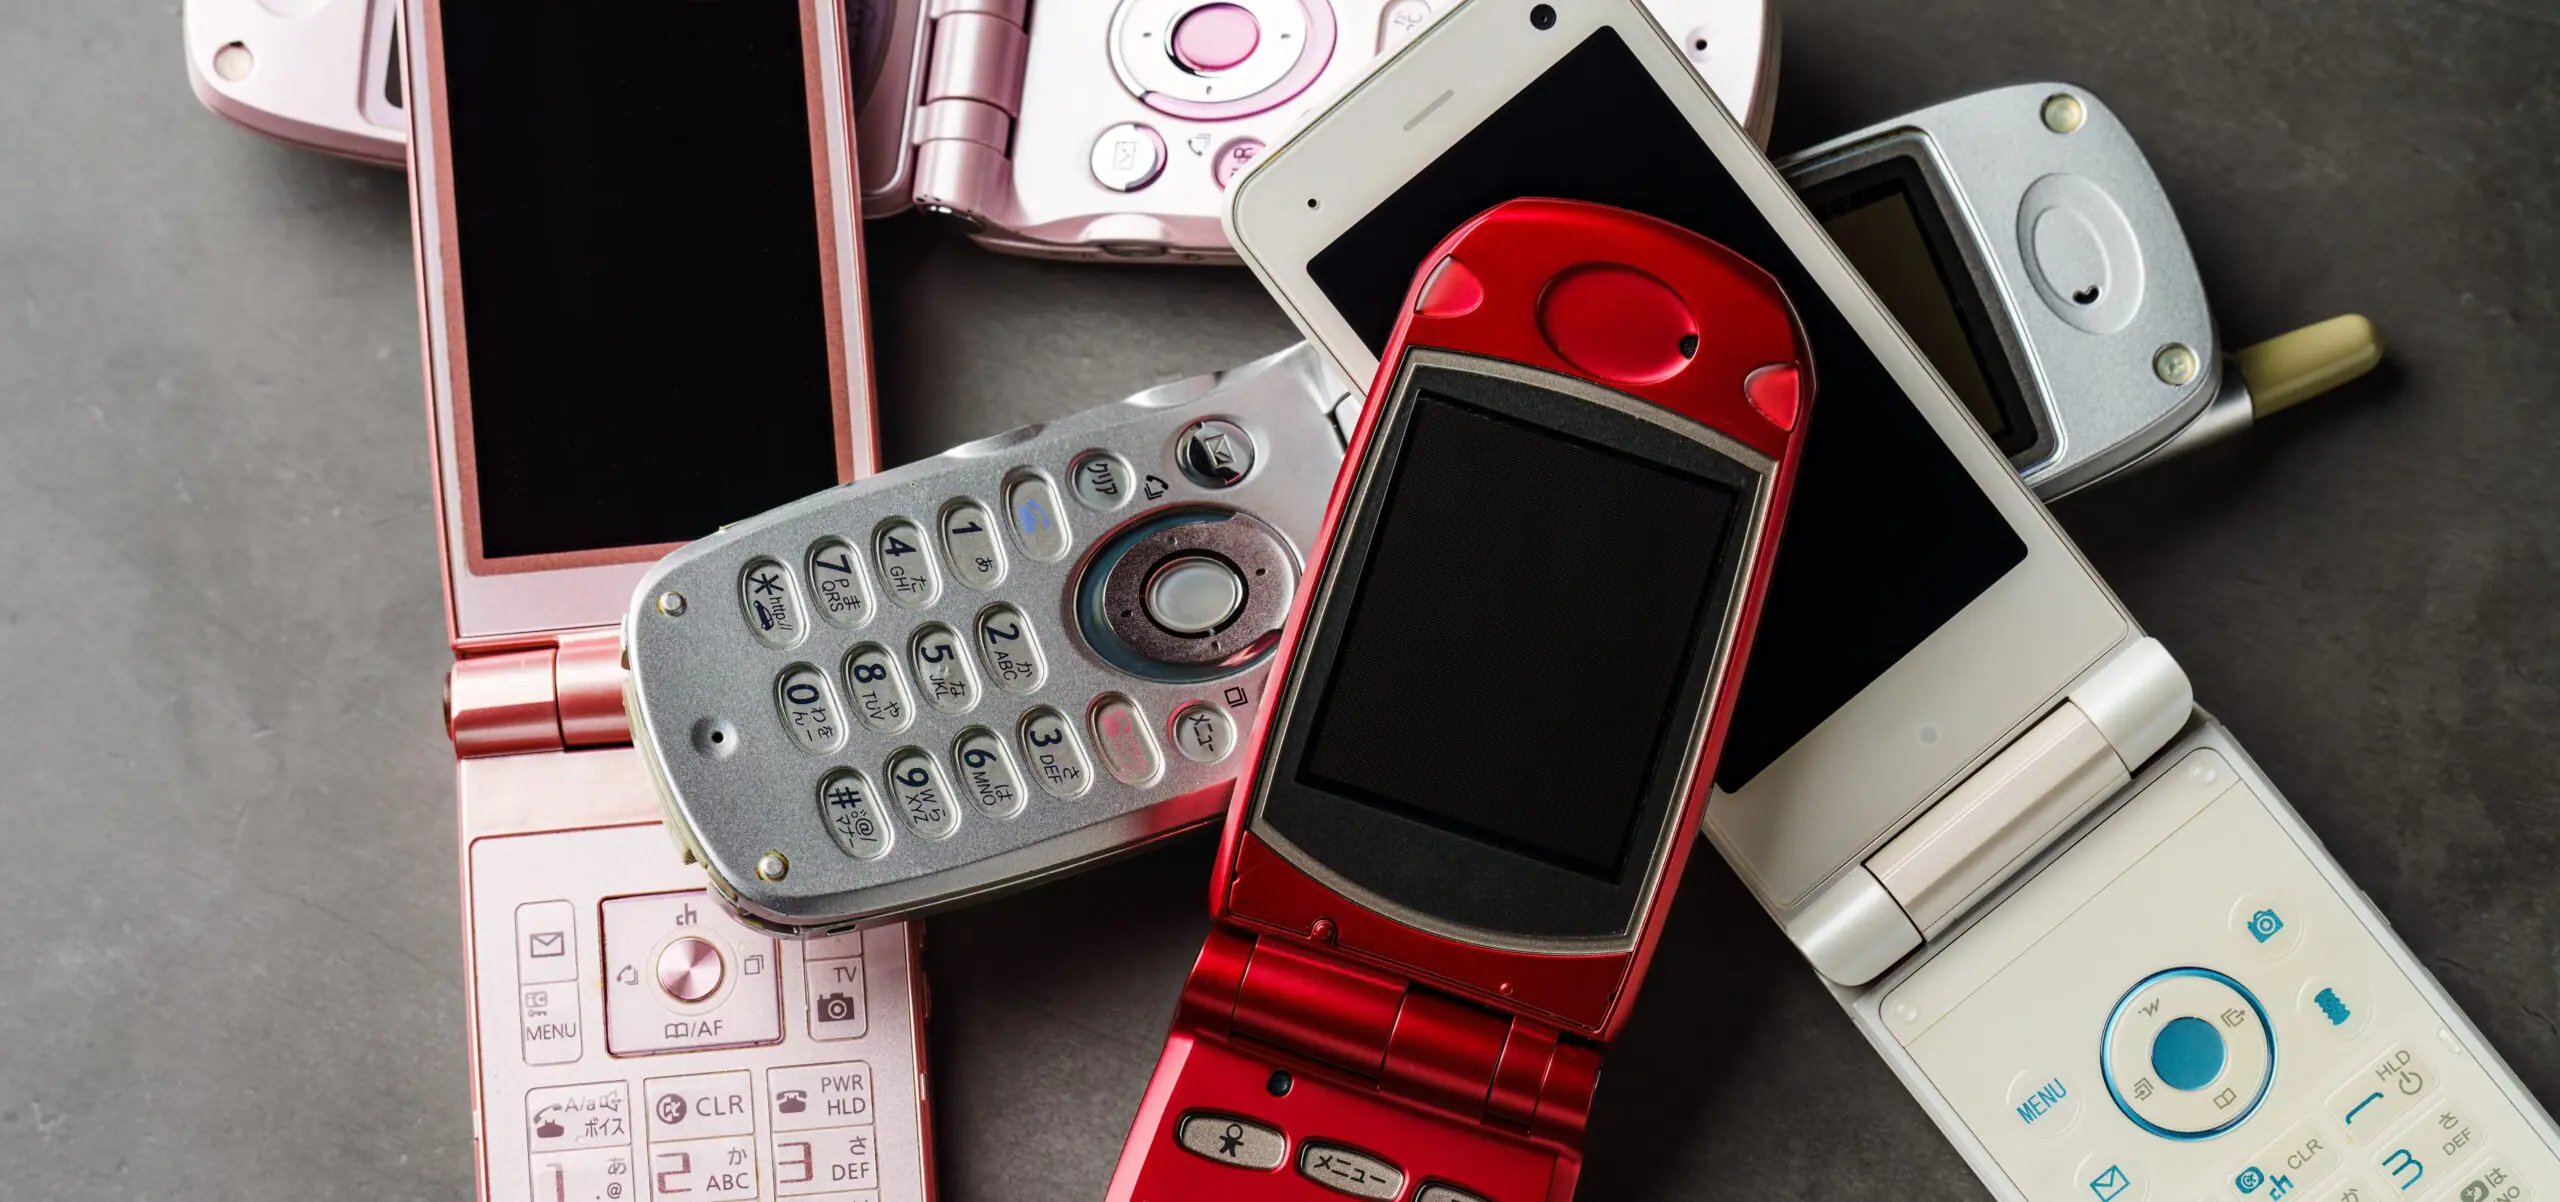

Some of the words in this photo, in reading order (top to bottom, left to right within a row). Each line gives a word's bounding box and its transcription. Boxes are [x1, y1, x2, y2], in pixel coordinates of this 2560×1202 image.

[1086, 463, 1119, 495] クリア
[952, 521, 984, 535] 1
[884, 536, 917, 557] 4
[816, 554, 852, 575] 7
[975, 556, 993, 573] あ
[890, 565, 911, 592] GHI
[910, 575, 927, 593] た
[821, 580, 844, 613] QRS
[843, 595, 861, 611] ま
[769, 596, 793, 631] http://
[985, 622, 1020, 645] 2
[920, 644, 955, 663] 5
[853, 663, 887, 684] 8
[993, 650, 1018, 681] ABC
[1015, 660, 1033, 678] か
[786, 683, 820, 705] 0
[929, 674, 949, 700] JKL
[949, 680, 966, 698] な
[861, 690, 886, 720] TUV
[883, 701, 900, 718] や
[1029, 728, 1063, 747] 3
[1188, 714, 1214, 752] メニュー
[963, 749, 997, 769] 6
[1039, 754, 1063, 784] DEF
[896, 767, 929, 787] 9
[1063, 766, 1080, 779] さ
[972, 771, 997, 806] MNO
[994, 784, 1013, 802] は
[905, 793, 929, 824] XYZ
[929, 808, 946, 822] ら
[835, 814, 855, 848] マナー
[676, 903, 697, 926] ch
[833, 966, 857, 983] TV
[526, 1022, 576, 1041] MENU
[2375, 1049, 2411, 1082] HLD
[821, 1074, 864, 1093] PWR
[565, 1097, 596, 1112] A/a
[695, 1094, 745, 1116] CLR
[827, 1097, 866, 1116] HLD
[2016, 1077, 2067, 1125] MENU
[584, 1117, 625, 1138] ボイス
[2438, 1111, 2460, 1130] さ
[849, 1136, 867, 1155] さ
[2442, 1127, 2472, 1156] DEF
[727, 1146, 747, 1166] か
[777, 1141, 814, 1183] 3
[2287, 1138, 2324, 1170] CLR
[607, 1156, 627, 1176] あ
[656, 1151, 692, 1194] 2
[831, 1162, 870, 1181] DEF
[1313, 1155, 1386, 1184] メニュー
[2382, 1148, 2424, 1191] 3
[705, 1172, 749, 1192] ABC
[2268, 1174, 2295, 1202] ch
[2484, 1167, 2507, 1188] は
